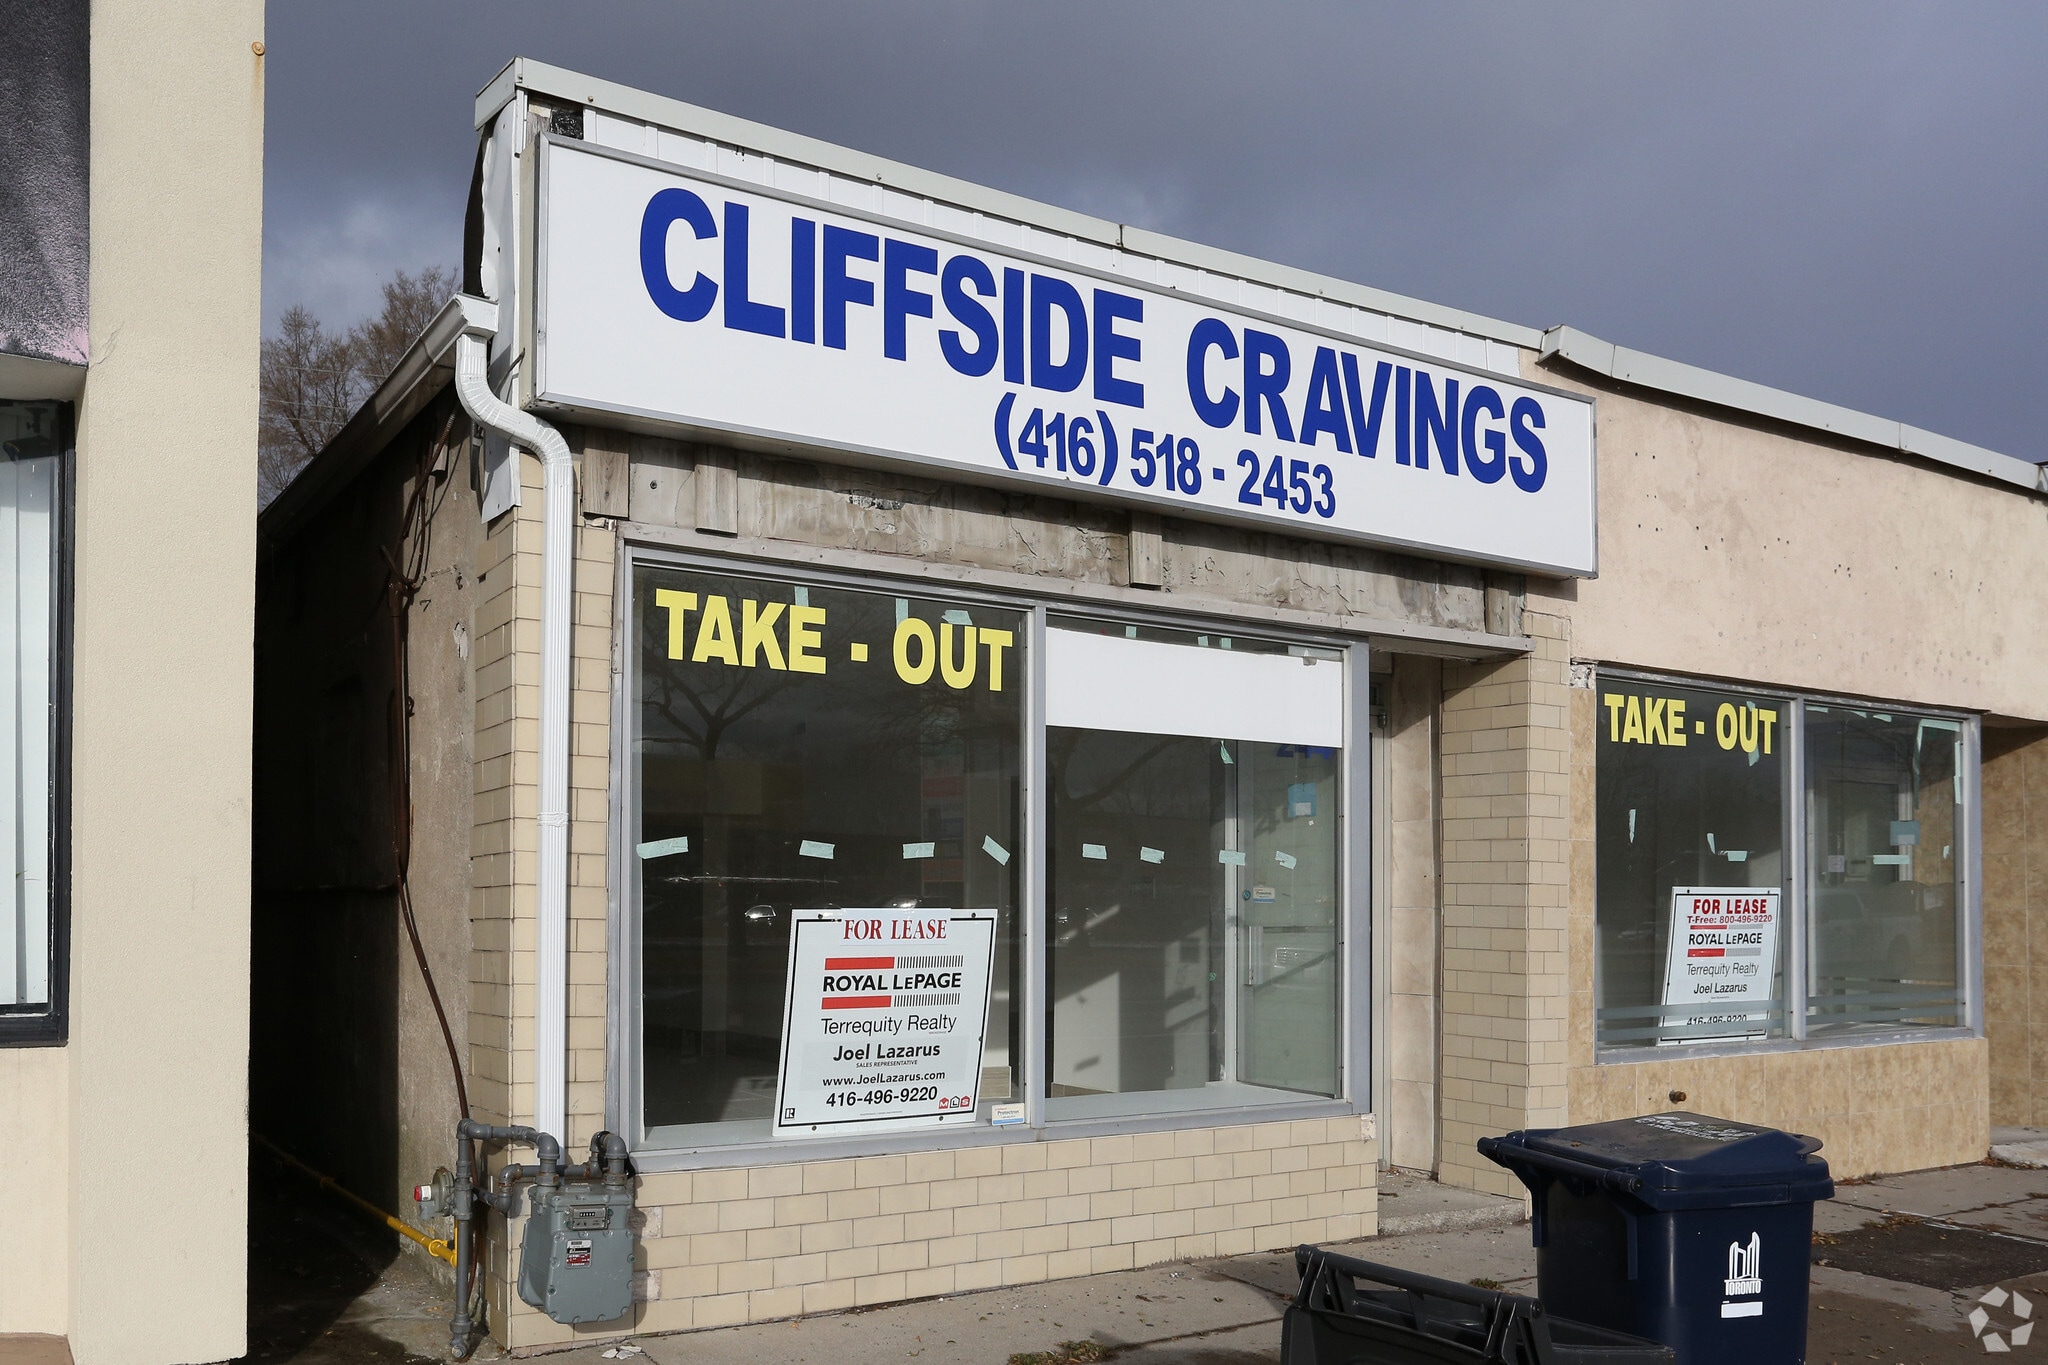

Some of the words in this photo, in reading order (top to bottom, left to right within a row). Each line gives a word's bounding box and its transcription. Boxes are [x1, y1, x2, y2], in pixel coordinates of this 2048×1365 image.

[640, 187, 1145, 409] CLIFFSIDE
[1187, 318, 1548, 493] CRAVINGS
[994, 391, 1119, 485] (416)
[1130, 428, 1202, 496] 518
[1236, 448, 1336, 519] 2453
[655, 588, 827, 675] TAKE
[892, 617, 1013, 692] OUT
[1604, 693, 1687, 747] TAKE
[1716, 702, 1777, 755] OUT
[1693, 898, 1721, 915] FOR
[1726, 898, 1767, 915] LEASE
[1687, 915, 1717, 923] T-Free:
[1719, 914, 1773, 923] 800-496-9220
[843, 919, 882, 940] FOR
[890, 919, 948, 940] LEASE
[1688, 933, 1724, 945] ROYAL
[1687, 963, 1730, 978] Terrequity
[1732, 962, 1759, 977] Realty
[823, 975, 888, 992] ROYAL
[1693, 982, 1713, 994] Joel
[1714, 982, 1748, 994] Lazarus
[821, 1015, 903, 1037] Terrequity
[907, 1014, 957, 1033] Realty
[833, 1043, 871, 1062] Joel
[876, 1043, 941, 1060] Lazarus
[873, 1059, 918, 1068] REPRESENTATIVE
[822, 1071, 946, 1088] www.JoelLazarus.com
[825, 1085, 938, 1108] 416-496-9220
[1724, 1280, 1762, 1296] TORONTO
